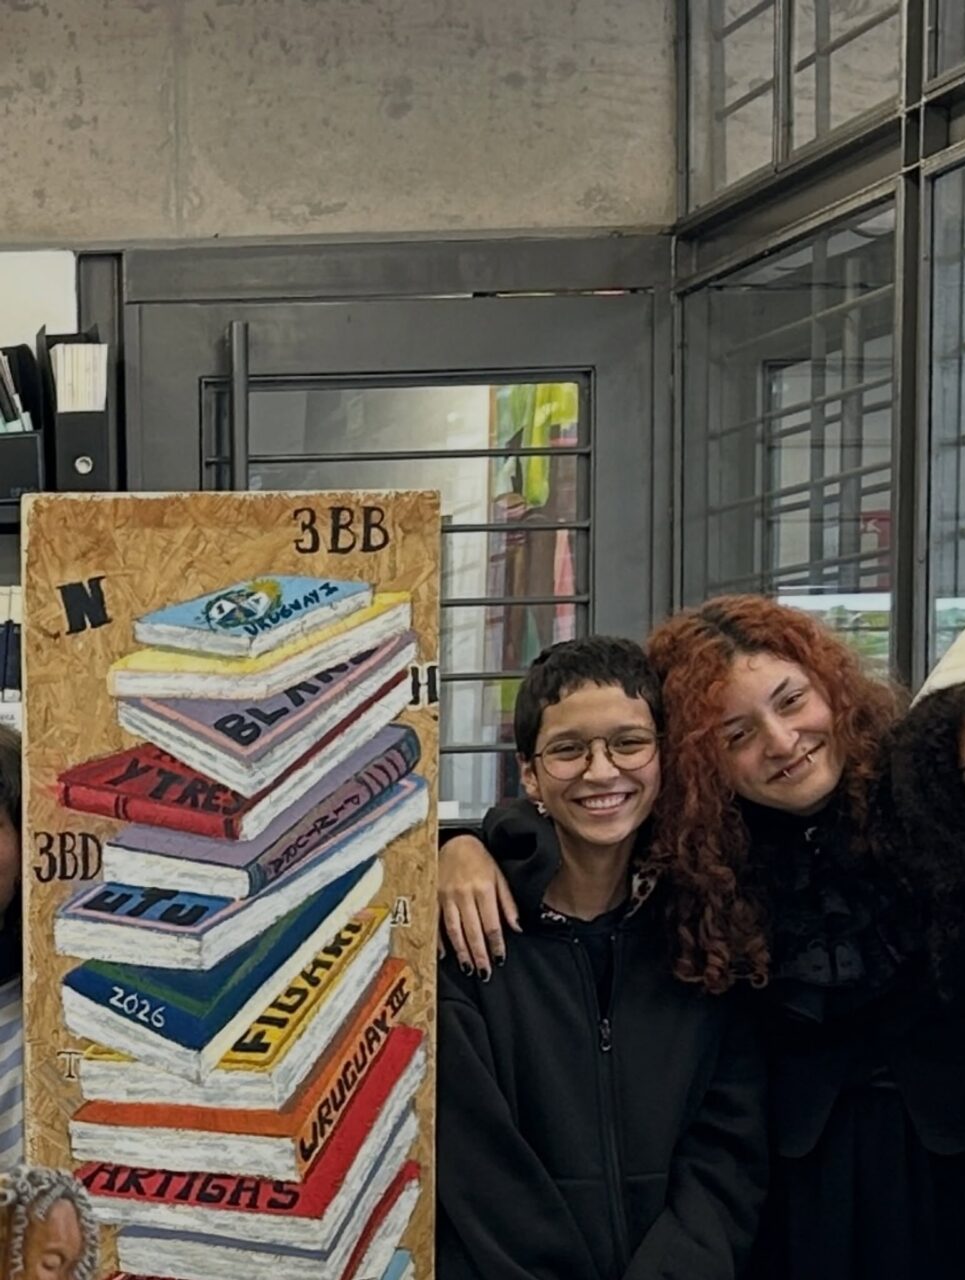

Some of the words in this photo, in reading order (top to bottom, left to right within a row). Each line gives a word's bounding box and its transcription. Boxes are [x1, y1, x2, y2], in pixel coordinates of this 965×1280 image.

[293, 505, 391, 554] 3BB
[57, 575, 113, 636] N
[409, 665, 439, 706] H
[33, 832, 102, 883] 3BD
[392, 898, 411, 926] A
[109, 986, 166, 1029] 2026
[57, 1050, 85, 1079] T
[300, 1010, 393, 1163] URUGUAY
[81, 1161, 301, 1210] ARTIGAS
